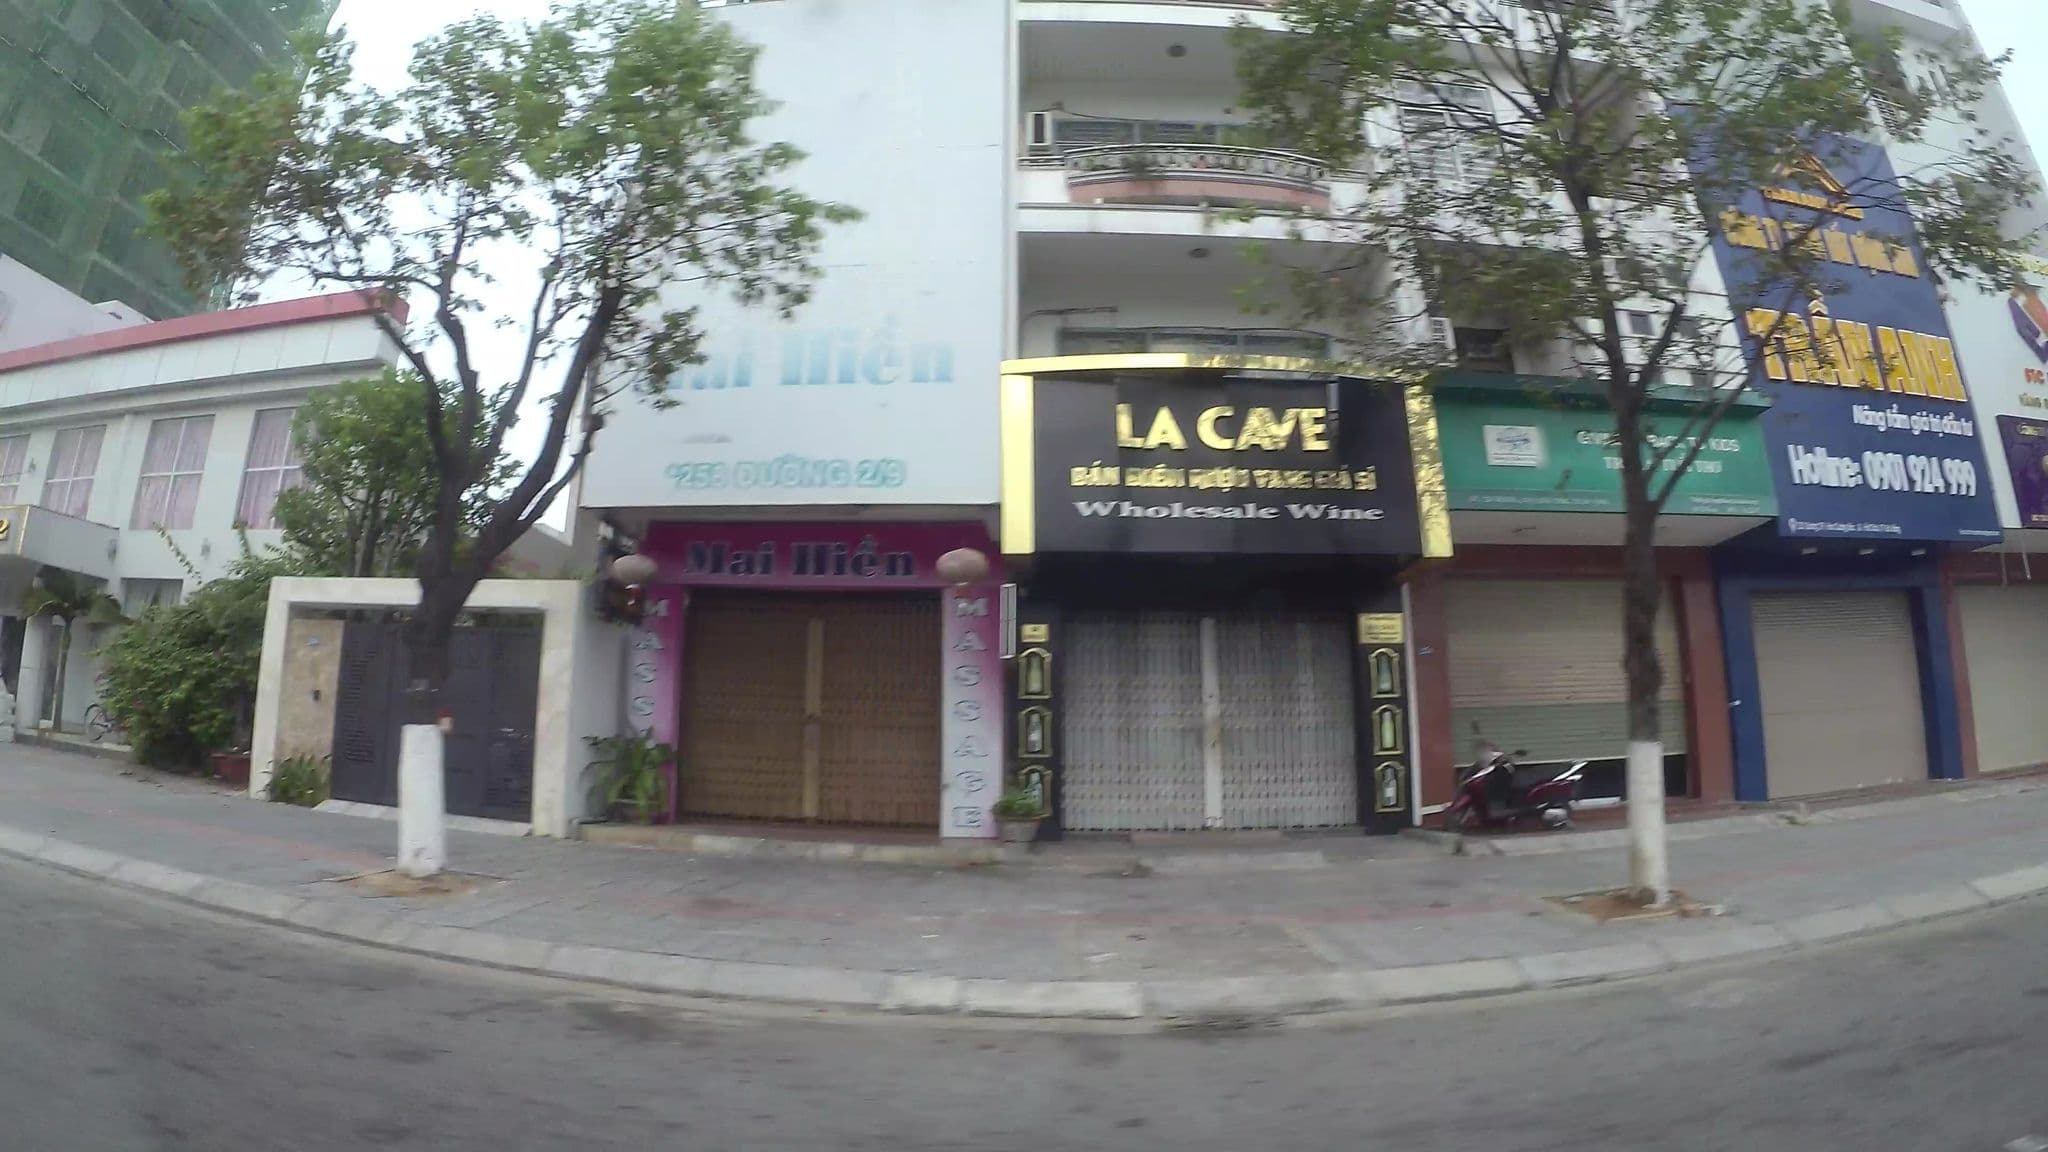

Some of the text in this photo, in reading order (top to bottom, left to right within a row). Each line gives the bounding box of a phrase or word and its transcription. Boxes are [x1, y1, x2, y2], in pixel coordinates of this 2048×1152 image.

[1115, 403, 1331, 451] LA CAVE
[1906, 454, 1946, 493] 924
[1942, 457, 1977, 498] 999
[1072, 500, 1386, 520] Wholesale Wine
[684, 540, 778, 577] Mai
[952, 596, 989, 830] MASSAGE
